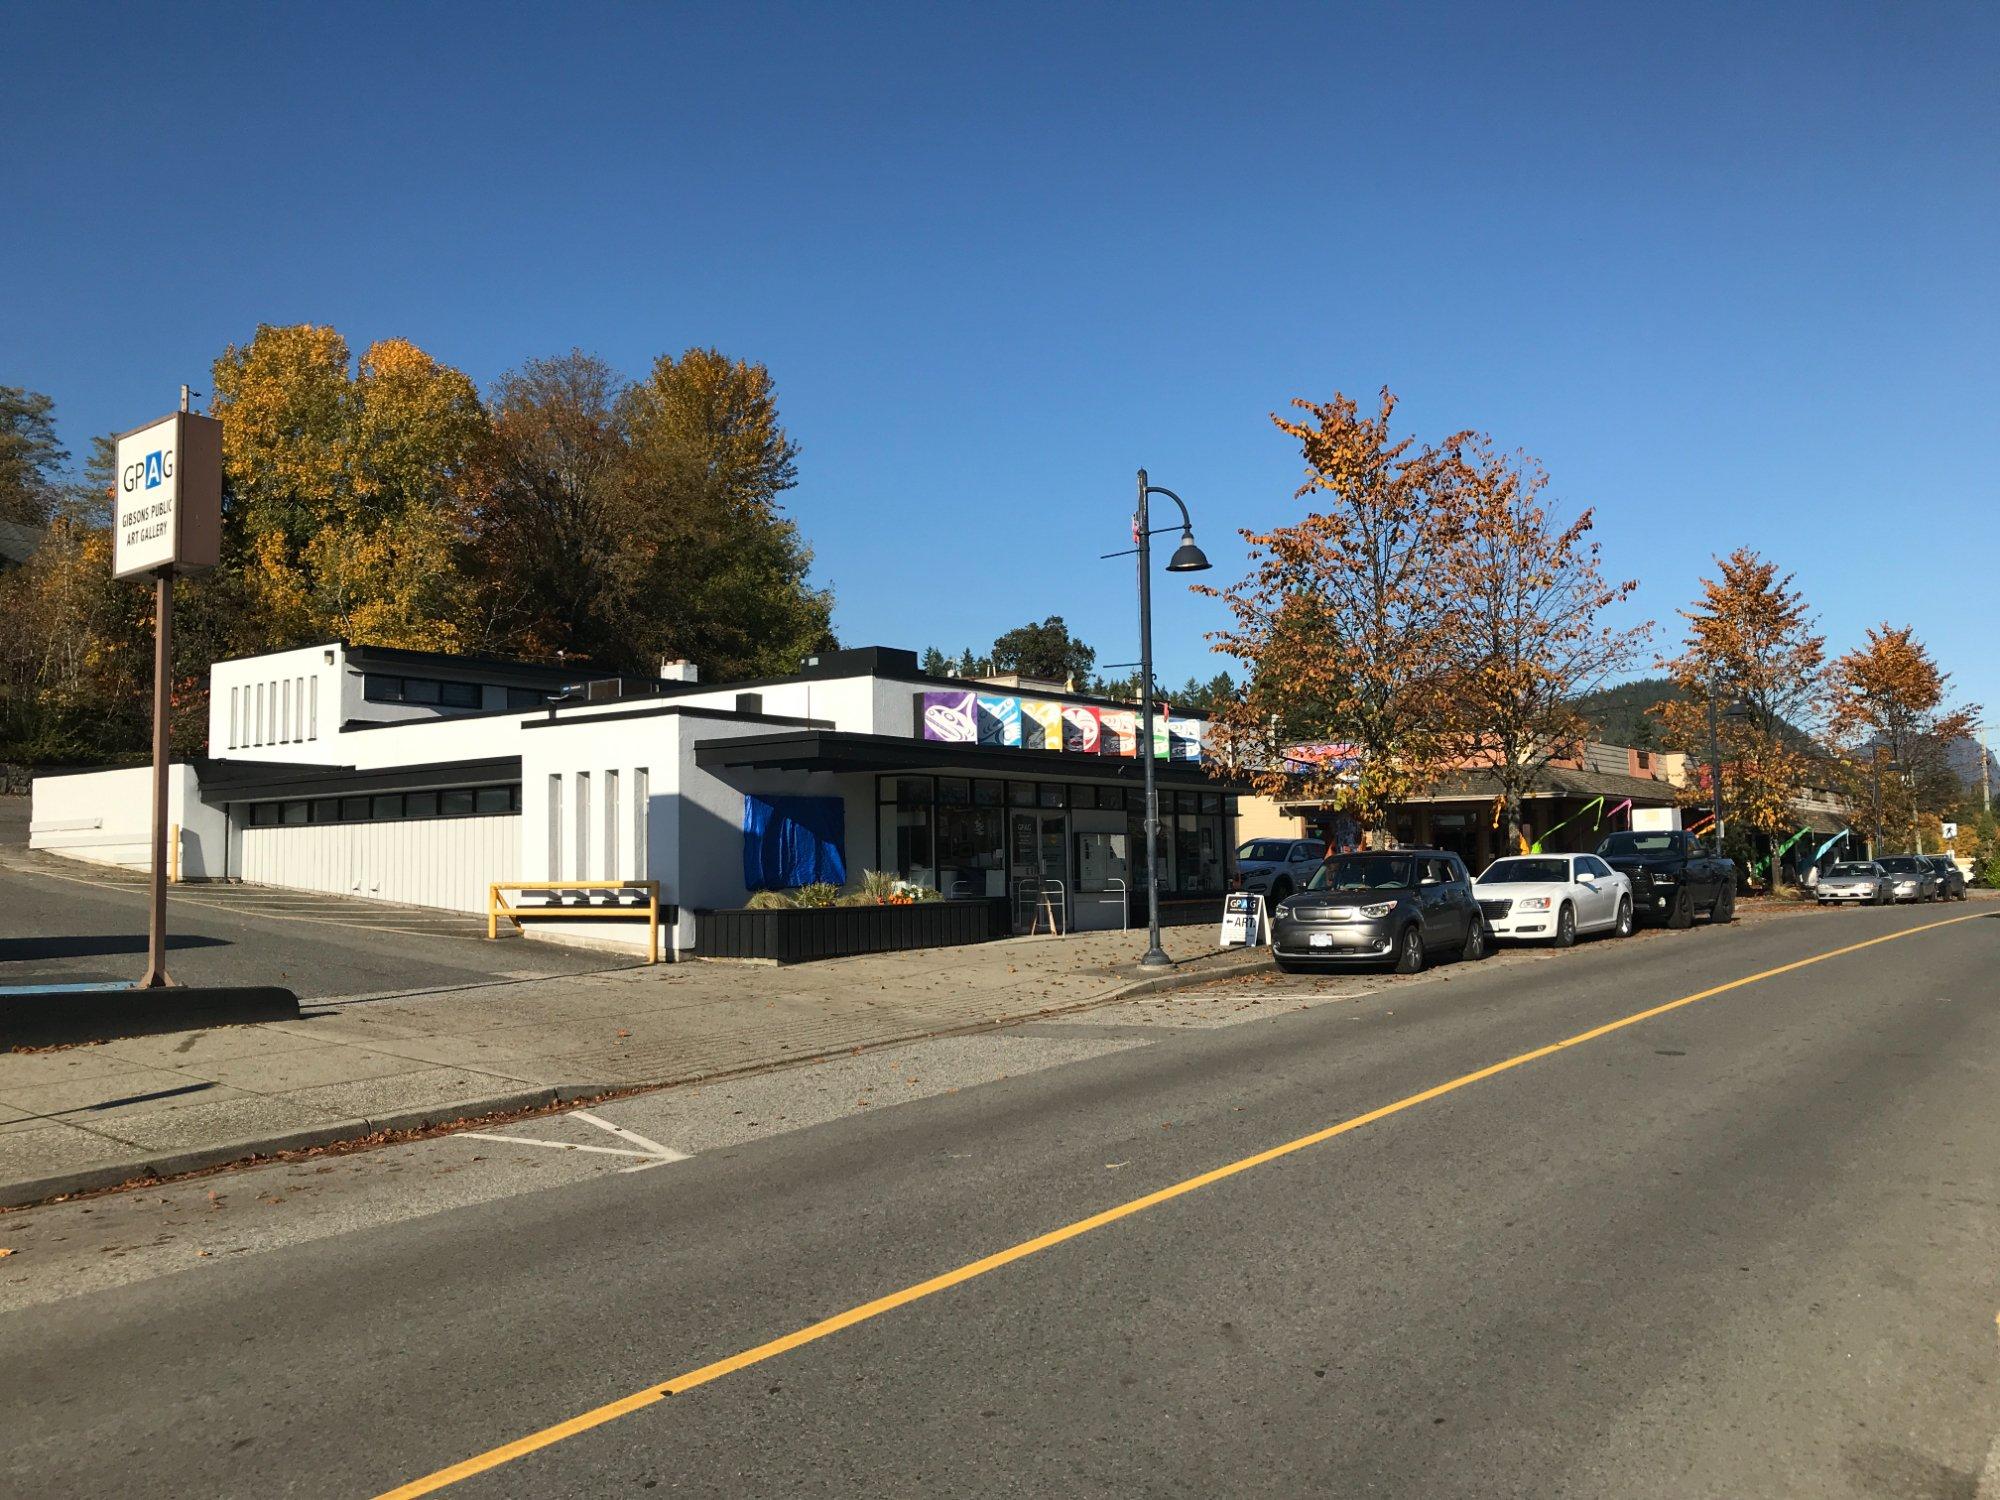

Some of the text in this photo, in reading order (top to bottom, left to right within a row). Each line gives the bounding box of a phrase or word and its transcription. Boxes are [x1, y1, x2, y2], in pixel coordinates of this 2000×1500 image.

[124, 450, 172, 492] GPAG
[122, 499, 172, 528] GIBSONS PUBLIC
[127, 522, 167, 546] ART GALLERY
